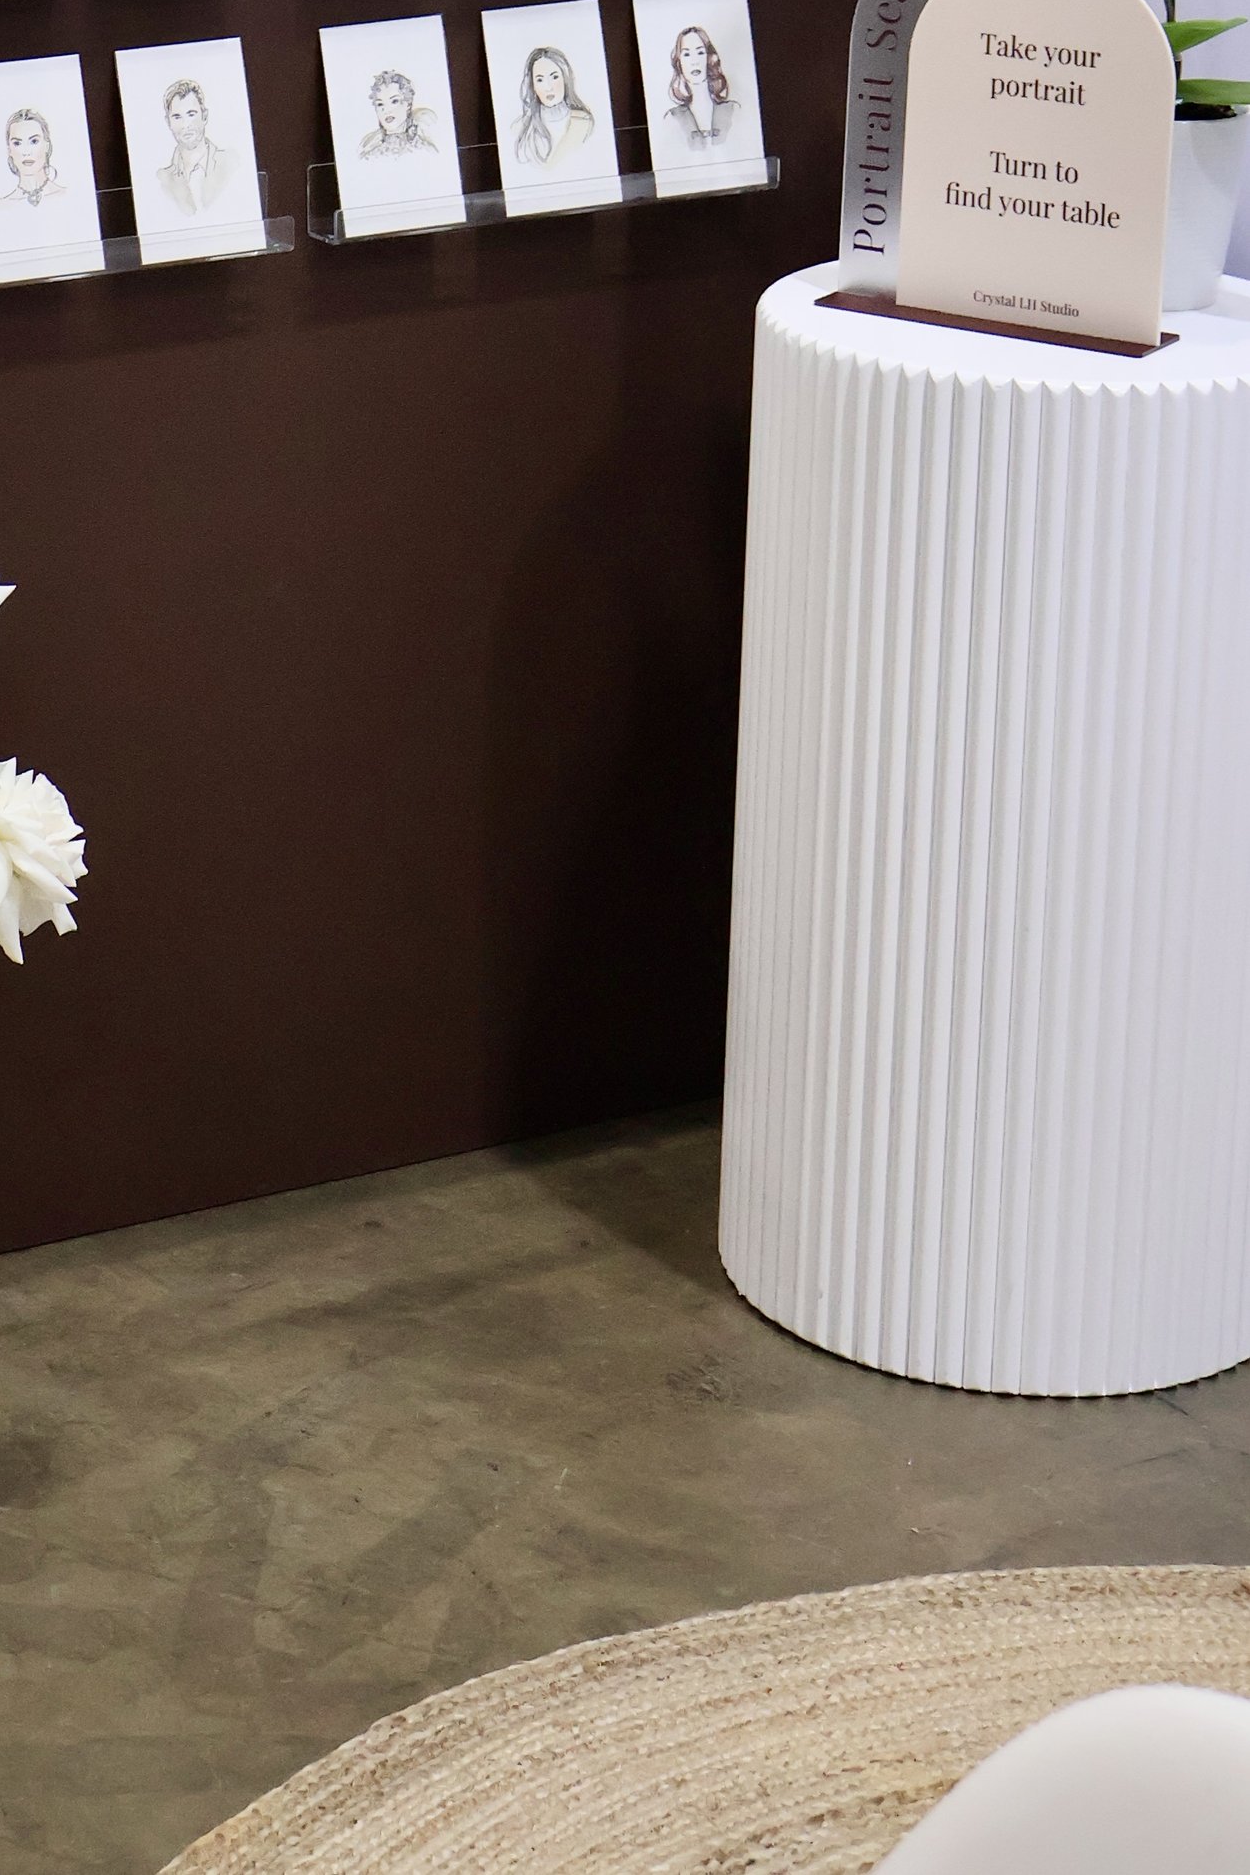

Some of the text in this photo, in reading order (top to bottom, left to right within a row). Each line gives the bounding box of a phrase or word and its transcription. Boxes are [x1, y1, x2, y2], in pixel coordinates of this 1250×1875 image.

[980, 32, 1102, 69] Take your
[990, 76, 1087, 106] portrait
[852, 76, 894, 256] Portrait
[989, 150, 1079, 185] Turn to
[944, 180, 1121, 229] find your table
[973, 289, 1016, 308] Crystal
[1040, 300, 1080, 318] Studio
